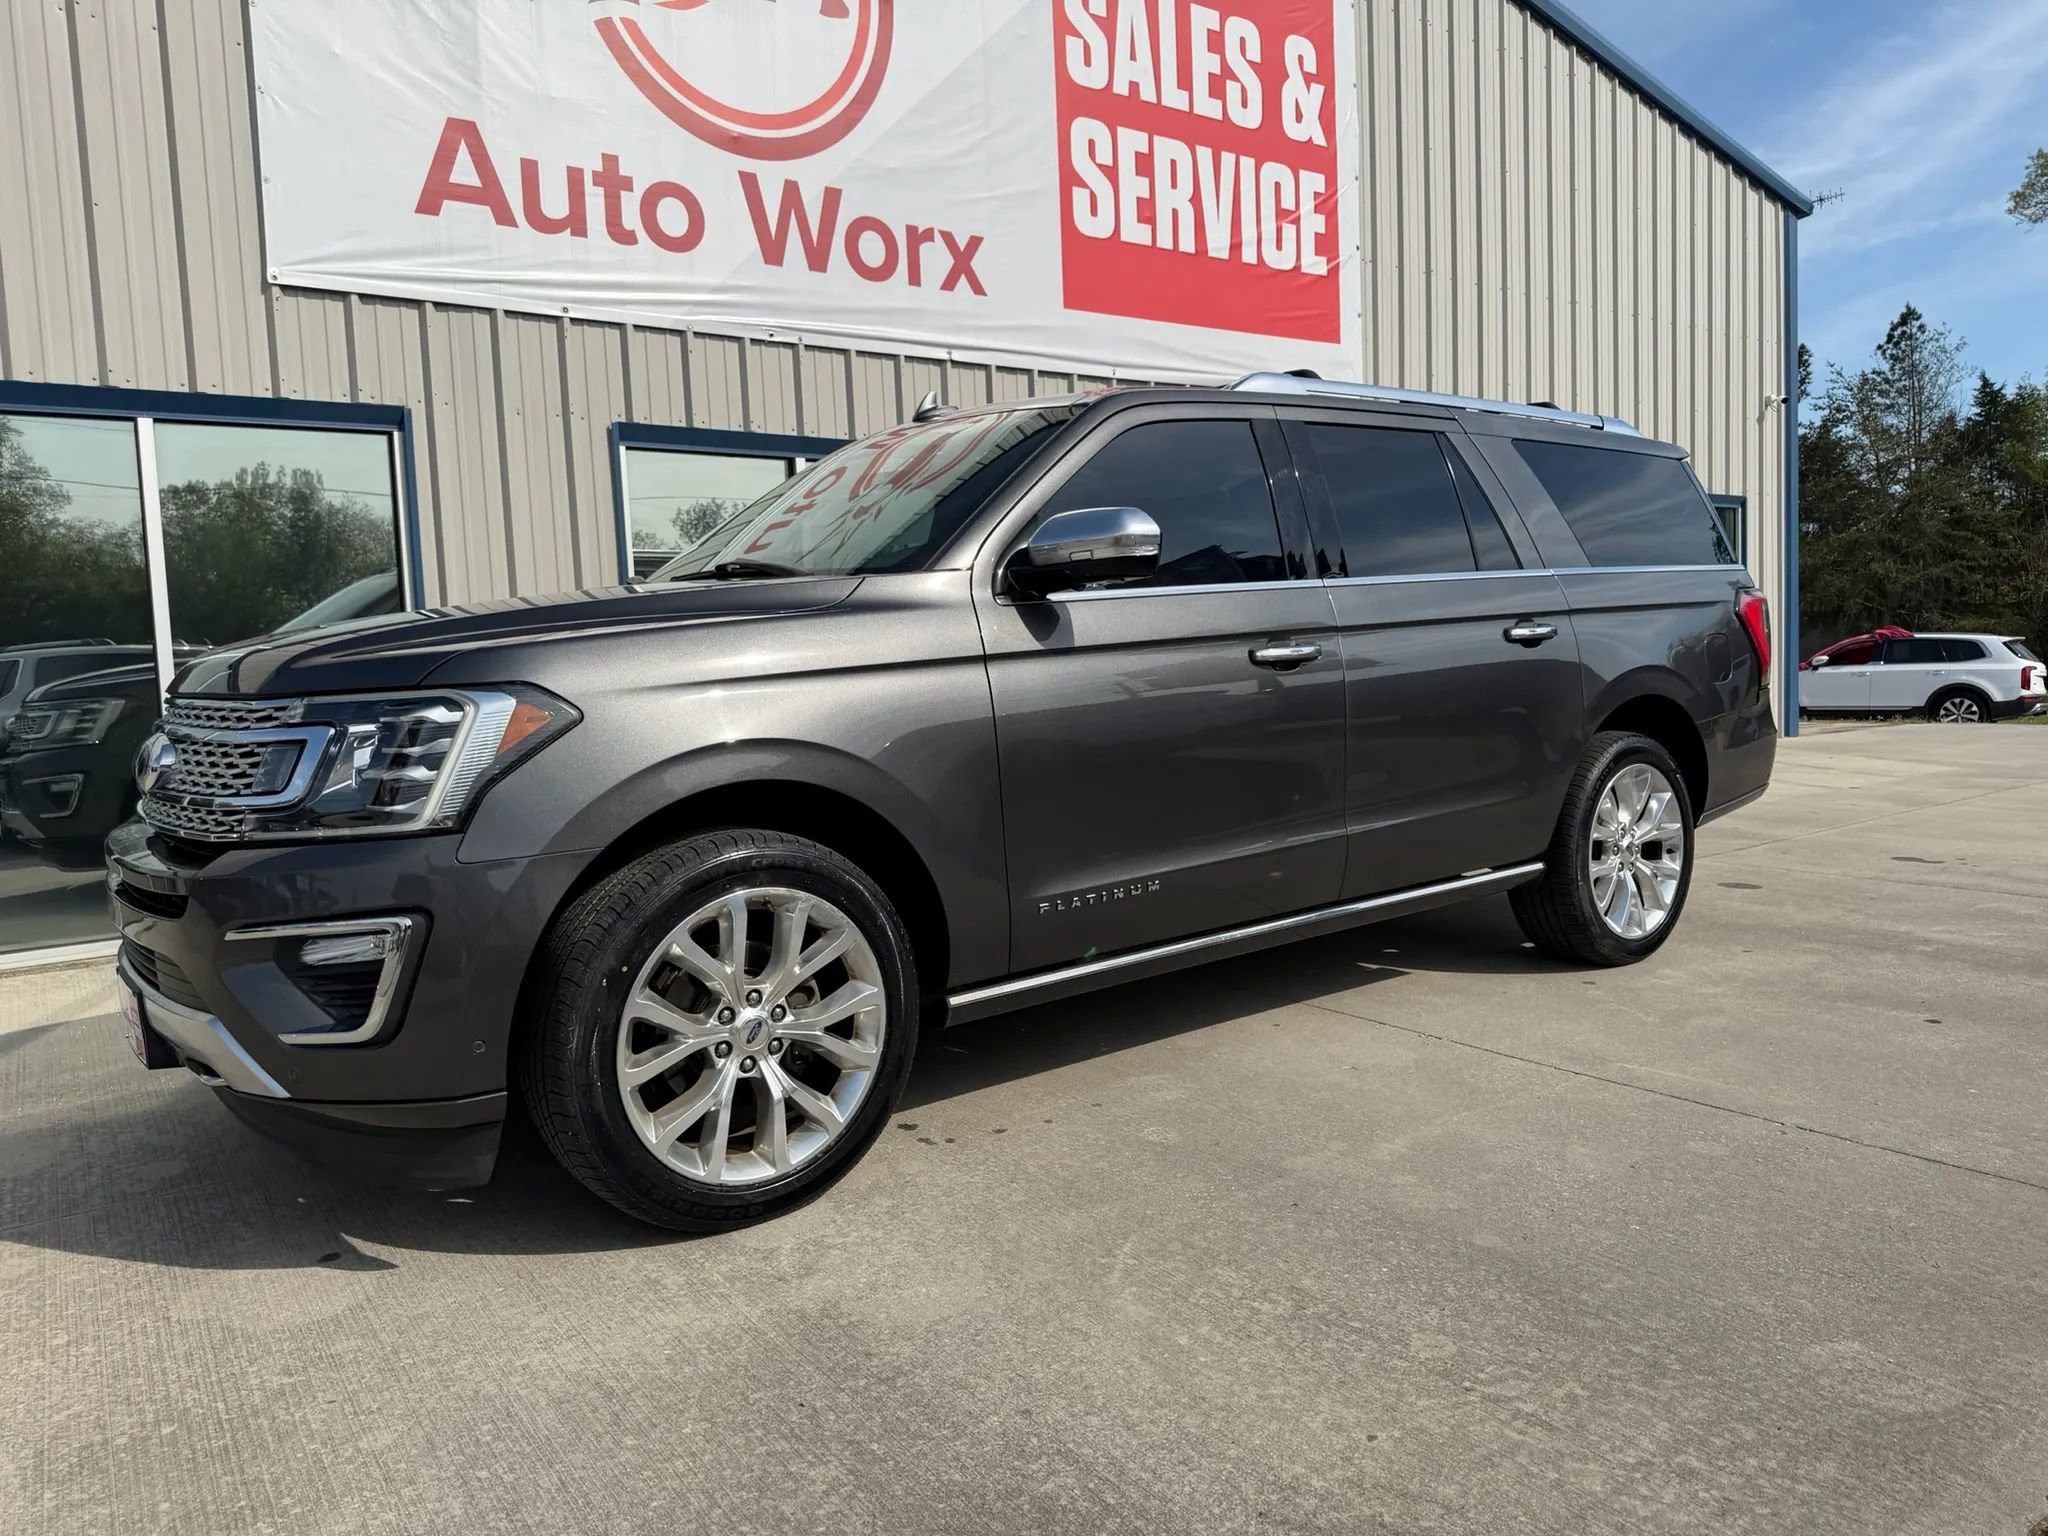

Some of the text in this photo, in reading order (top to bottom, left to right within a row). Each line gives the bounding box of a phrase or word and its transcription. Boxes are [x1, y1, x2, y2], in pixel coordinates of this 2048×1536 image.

[1064, 0, 1328, 147] SALES &
[414, 116, 988, 297] Auto Worx
[1069, 116, 1329, 277] SERVICE
[1038, 880, 1161, 914] PLATINUM
